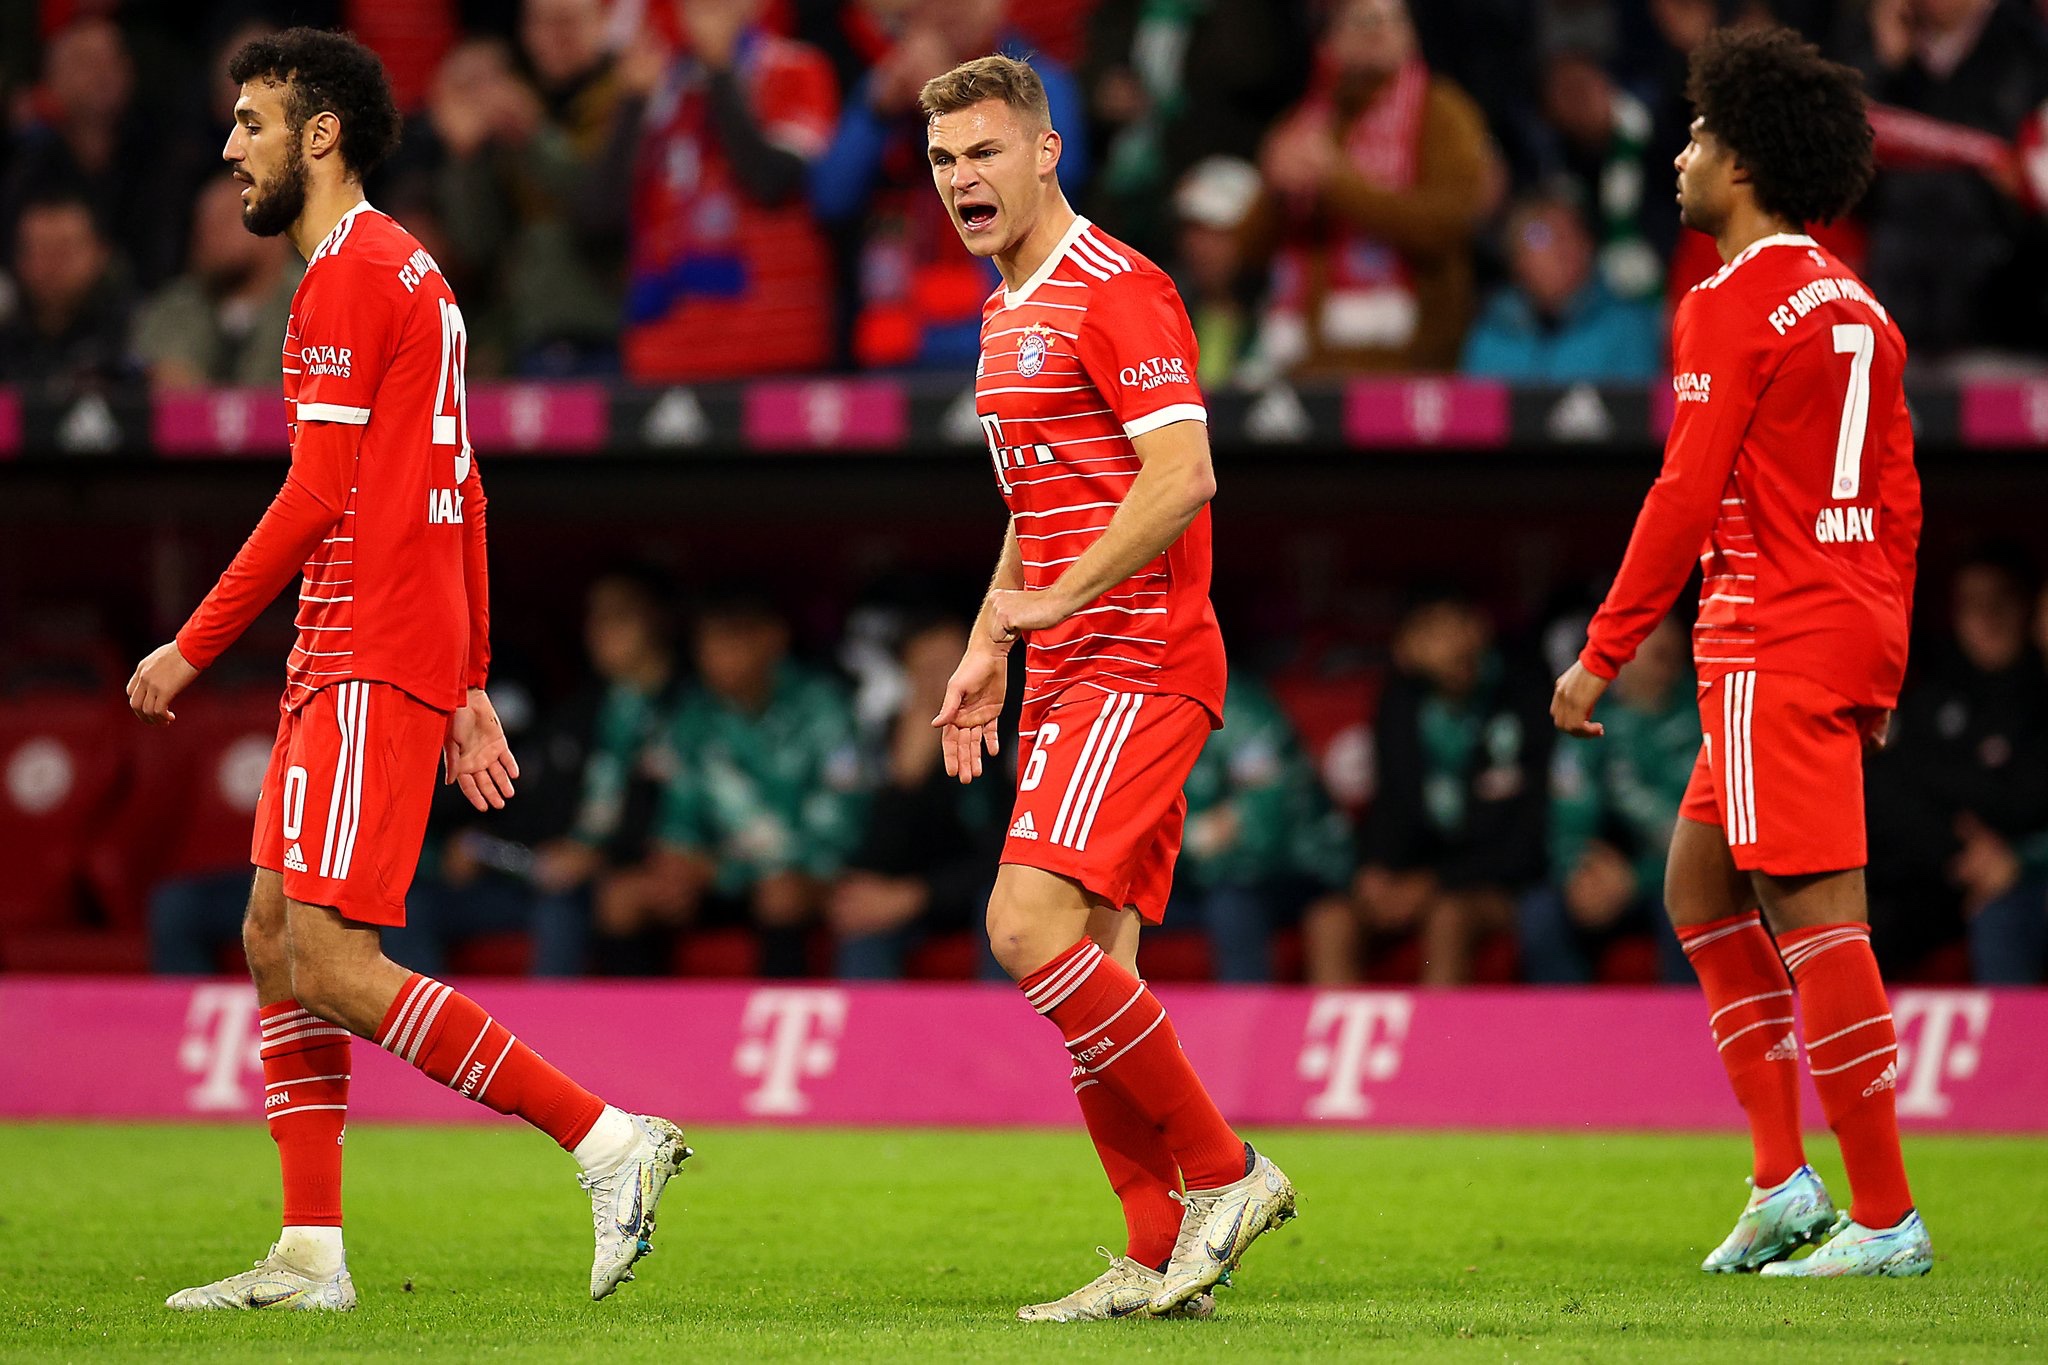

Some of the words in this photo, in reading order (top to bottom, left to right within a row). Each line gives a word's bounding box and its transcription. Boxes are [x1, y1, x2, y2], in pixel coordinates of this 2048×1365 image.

[397, 264, 421, 293] FC
[1768, 304, 1797, 336] FC
[1119, 356, 1186, 387] QATAR
[1141, 373, 1190, 392] AIRWAYS
[1832, 323, 1875, 500] 7
[1019, 722, 1061, 792] 6
[1009, 828, 1039, 841] adidas
[733, 986, 848, 1116] T
[1298, 990, 1413, 1119] T
